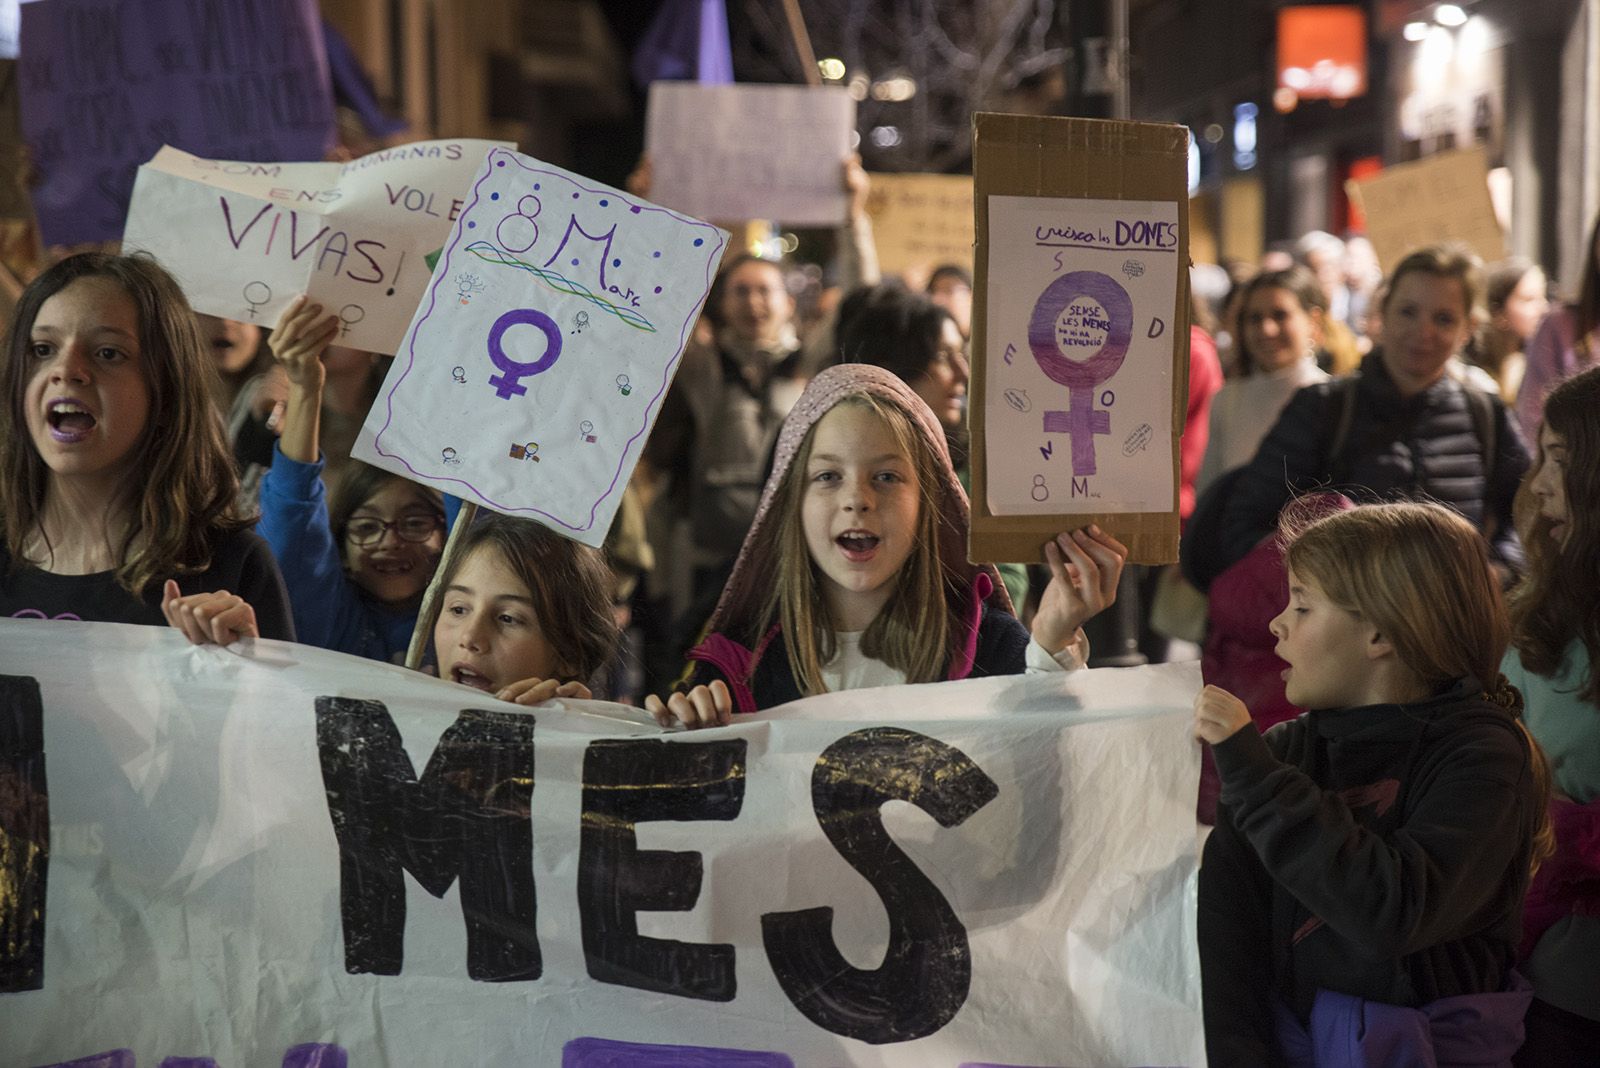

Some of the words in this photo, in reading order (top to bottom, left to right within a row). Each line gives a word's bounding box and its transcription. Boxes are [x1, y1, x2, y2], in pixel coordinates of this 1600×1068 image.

[341, 143, 463, 176] HUMANAS
[269, 187, 343, 202] ENS
[496, 194, 542, 253] 8
[1115, 220, 1178, 248] DONES
[220, 196, 406, 297] VIVAS!
[1053, 251, 1064, 272] S
[1069, 305, 1101, 317] SENSE
[1062, 317, 1080, 328] LES
[1082, 317, 1112, 332] NENES
[1147, 316, 1165, 339] D
[1003, 343, 1018, 366] E
[1100, 390, 1115, 407] O
[1031, 474, 1049, 502] 8
[314, 695, 999, 1046] MES
